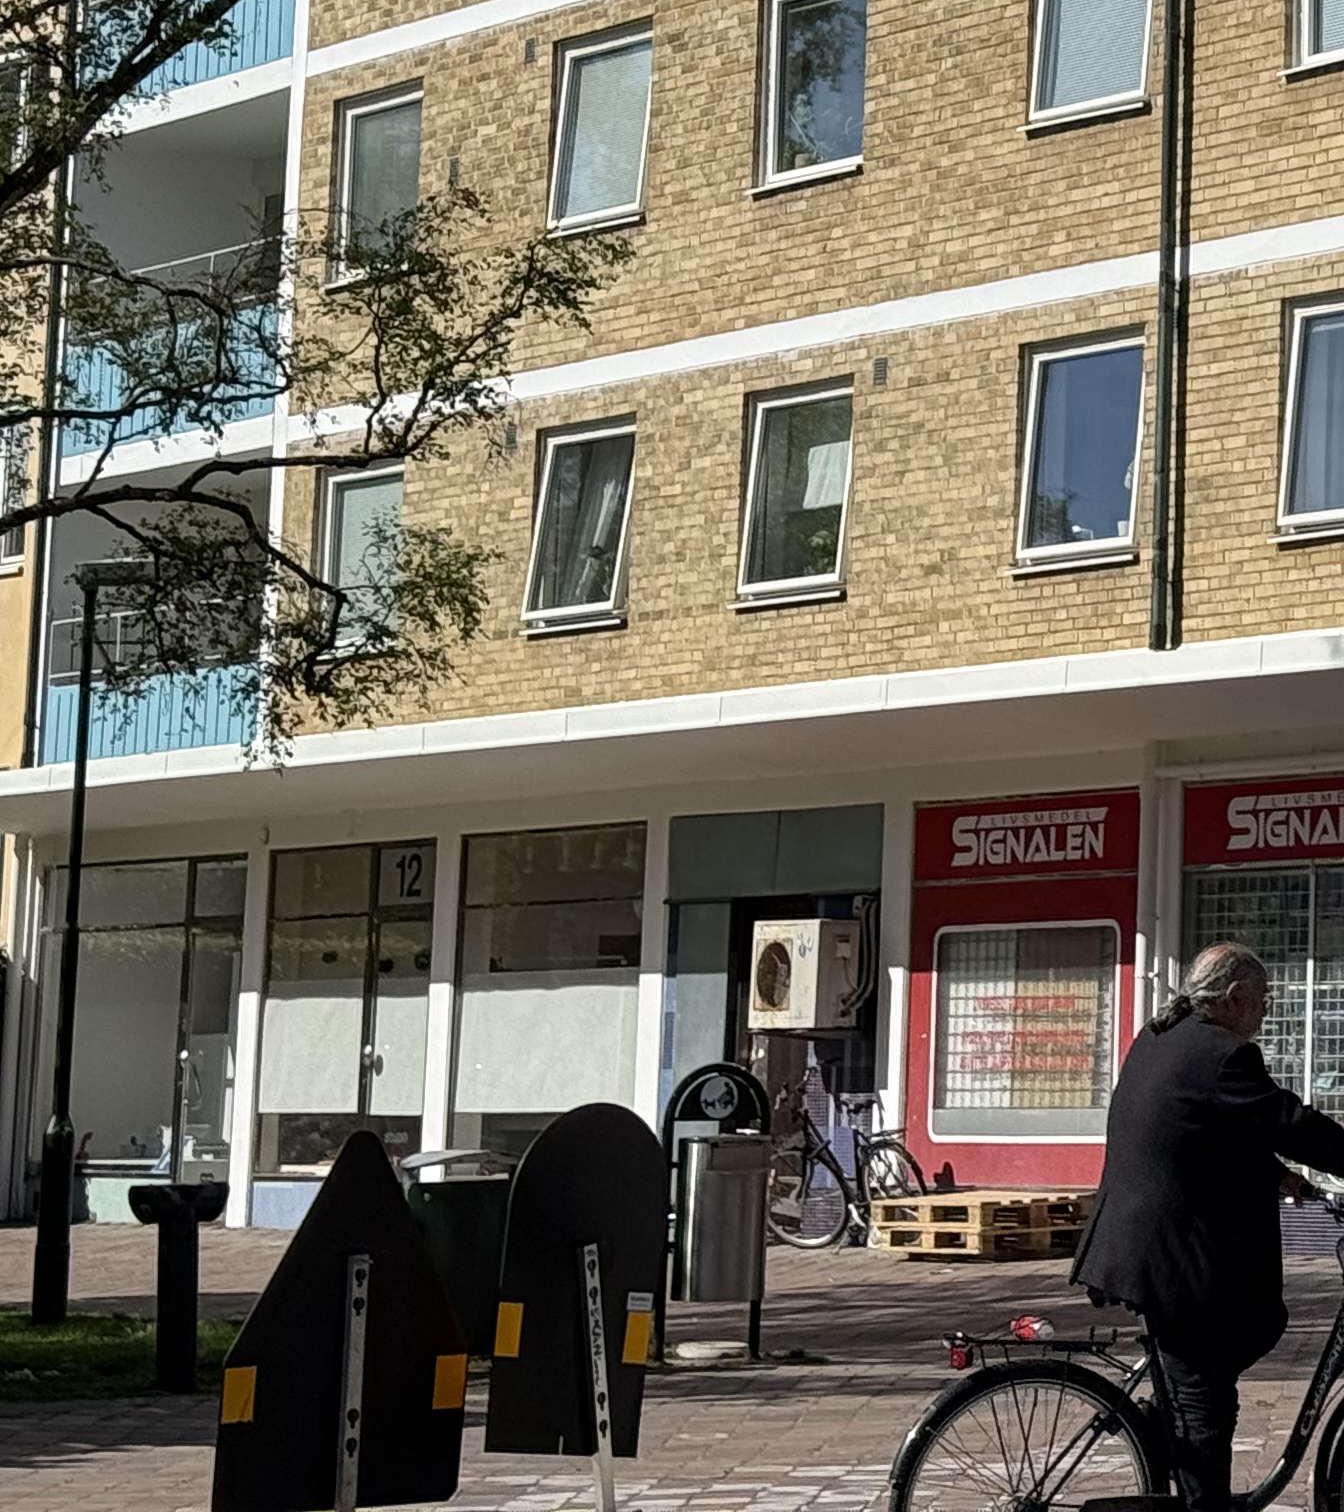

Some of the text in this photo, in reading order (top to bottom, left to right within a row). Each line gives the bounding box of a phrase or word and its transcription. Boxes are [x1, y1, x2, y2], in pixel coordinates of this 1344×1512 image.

[991, 810, 1091, 826] LIVSMEDEL
[951, 816, 1105, 866] SIGNALEN
[396, 853, 423, 898] 12
